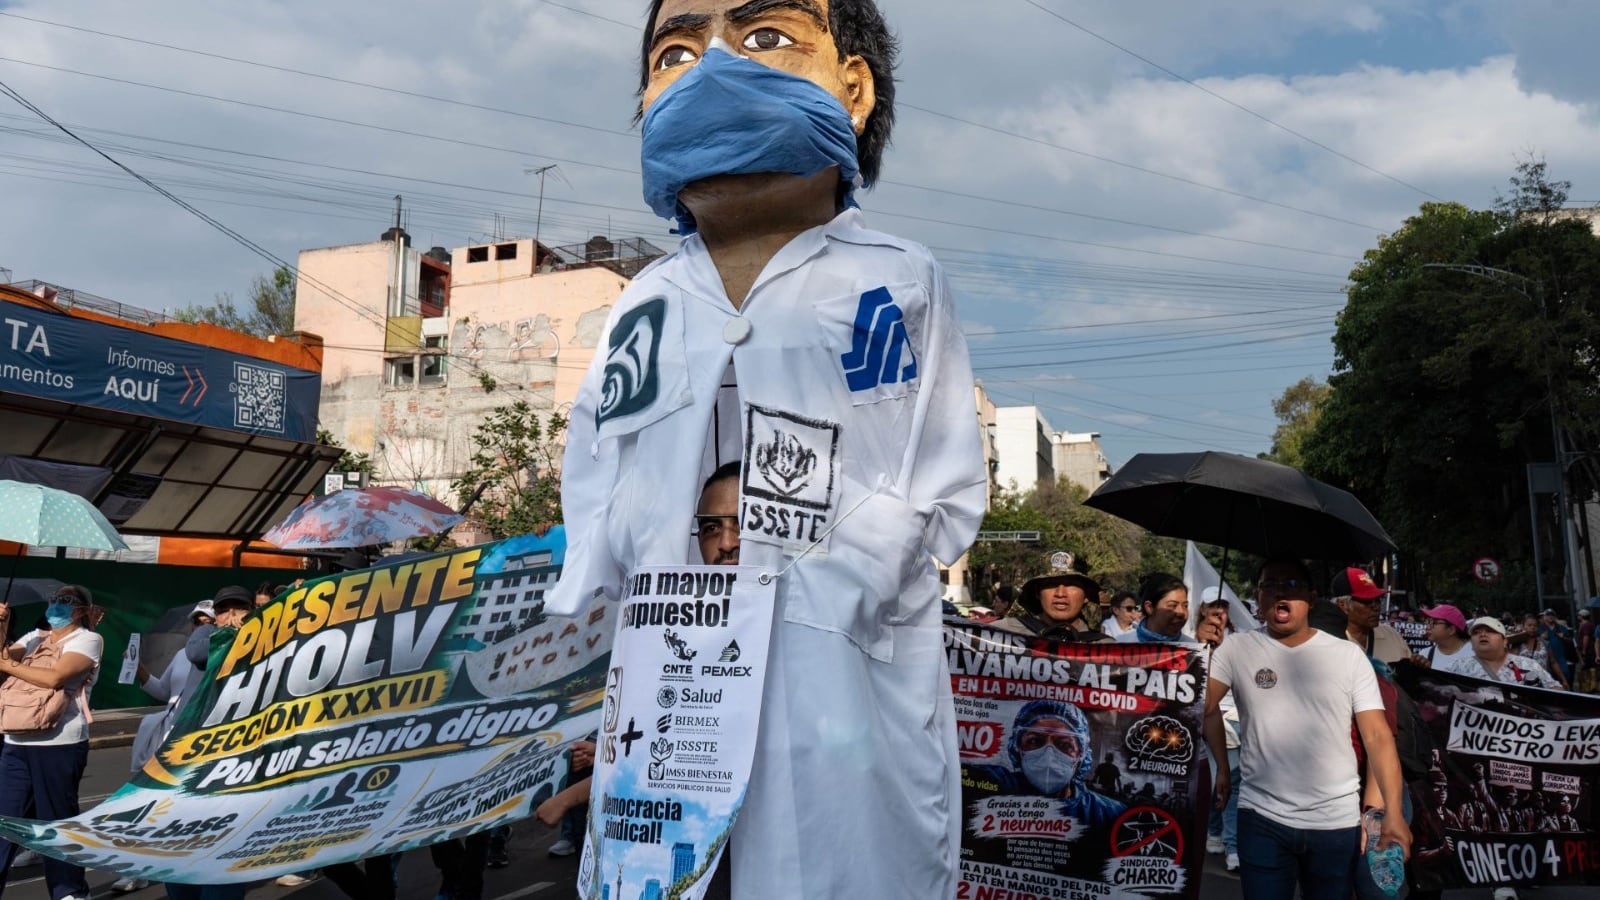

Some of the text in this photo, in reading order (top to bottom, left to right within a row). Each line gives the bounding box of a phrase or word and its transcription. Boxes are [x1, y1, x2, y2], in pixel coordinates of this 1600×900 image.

[5, 318, 50, 357] TA
[108, 347, 176, 376] Informes
[0, 363, 74, 389] mentos
[104, 376, 159, 403] AQUÍ
[741, 498, 826, 543] ISSSTE
[656, 572, 737, 598] mayor
[216, 549, 482, 680] PRESENTE
[512, 605, 606, 657] UMAE
[506, 633, 601, 676] HTOLV
[979, 630, 1026, 655] MIS
[1058, 641, 1188, 671] NEURONAS
[202, 602, 458, 728] HTOLV
[663, 664, 693, 674] CNTE
[701, 665, 752, 677] PEMEX
[947, 649, 1196, 704] LVAMOS AL PAÍS
[681, 688, 722, 703] Salud
[958, 678, 1138, 710] EN LA PANDEMIA COVID
[182, 675, 436, 761] SECCIÓN XXXVII
[675, 715, 720, 727] BIRMEX
[975, 710, 989, 718] ojos
[1454, 706, 1545, 740] ¡UNIDOS
[198, 703, 559, 789] Por un salario digno
[676, 740, 718, 753] ISSSTE
[1462, 730, 1600, 761] NUESTRO INS
[666, 768, 733, 780] IMSS BIENESTAR
[1129, 757, 1187, 776] 2 NEURONAS
[472, 760, 556, 818] individual.
[977, 780, 998, 791] vidas
[987, 798, 1021, 809] Gracias
[1032, 800, 1050, 809] dios
[997, 808, 1045, 819] solo tengo
[150, 812, 239, 838] base
[266, 813, 321, 828] Quieren
[320, 808, 349, 820] que
[604, 816, 663, 845] sindical!
[982, 814, 1072, 833] 2 neuronas
[1120, 859, 1169, 868] SINDICATO
[1457, 840, 1537, 883] GINECO
[1542, 839, 1561, 876] 4
[963, 872, 987, 884] ESTÁ
[991, 878, 1005, 888] EN
[1008, 880, 1049, 896] MANOS
[1053, 889, 1067, 899] DE
[973, 863, 981, 874] A
[984, 863, 1002, 877] DÍA
[1005, 868, 1019, 881] LA
[1022, 872, 1058, 888] SALUD
[1061, 879, 1081, 891] DEL
[1085, 881, 1111, 895] PAÍS
[1114, 867, 1178, 885] CHARRO
[956, 881, 971, 899] 2
